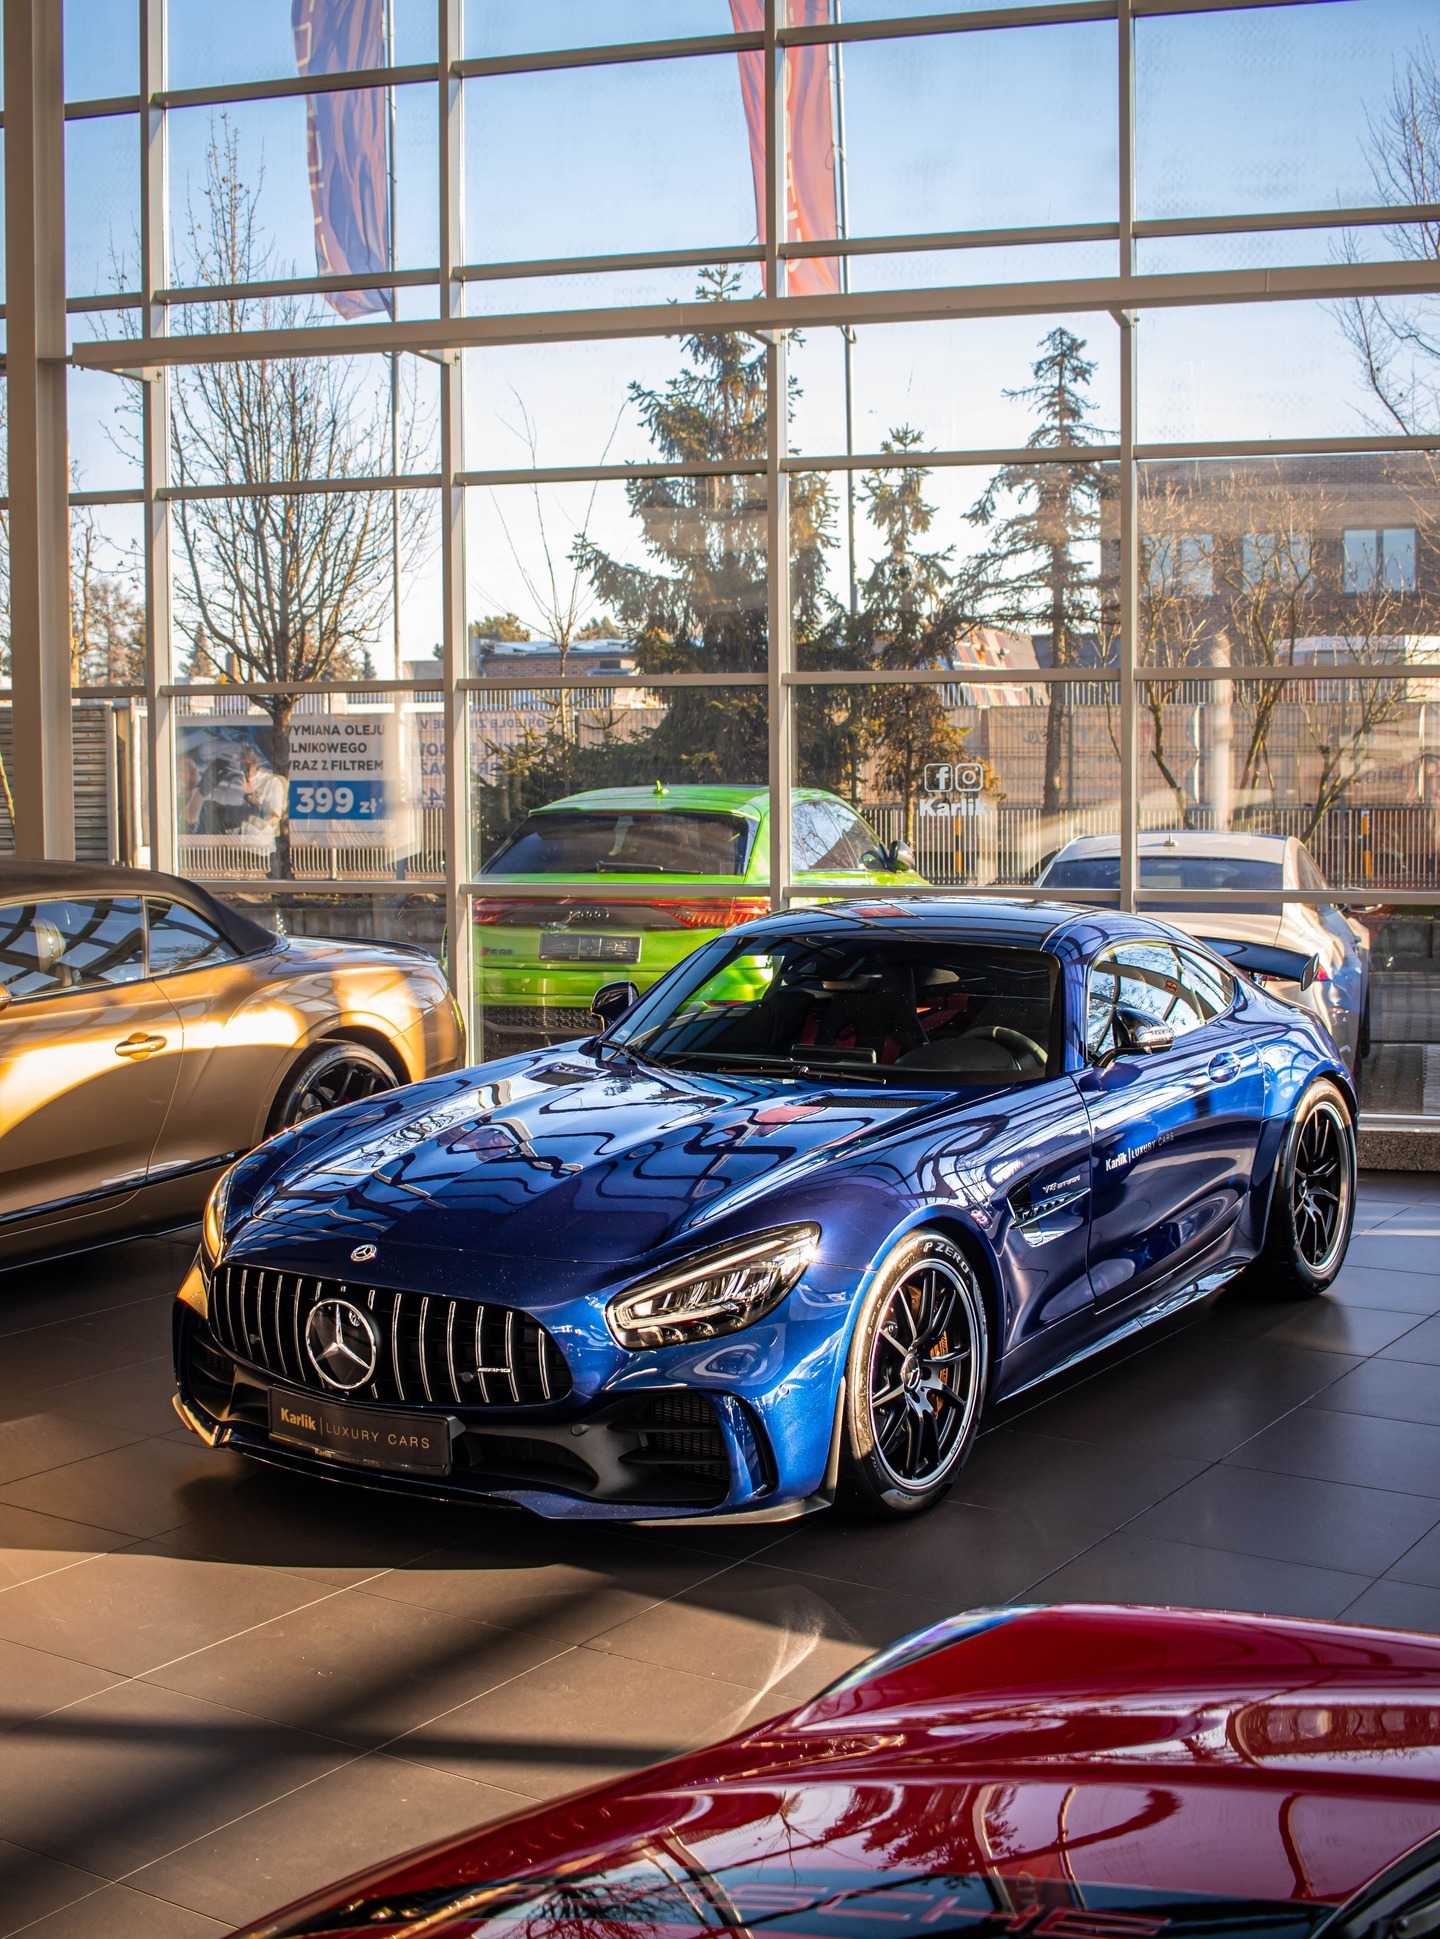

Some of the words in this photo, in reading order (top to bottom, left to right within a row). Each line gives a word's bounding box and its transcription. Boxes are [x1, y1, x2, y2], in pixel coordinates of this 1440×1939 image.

[344, 724, 385, 736] OLEJU
[289, 760, 318, 771] RAZ
[321, 760, 328, 771] Z
[331, 760, 384, 771] FILTREM
[295, 786, 355, 814] 399
[919, 798, 989, 817] Karlik
[1105, 1151, 1128, 1172] Karlik
[1131, 1140, 1156, 1159] LUXURY
[1157, 1131, 1175, 1147] CARS
[923, 1241, 933, 1253] P
[935, 1241, 970, 1274] ZERO
[280, 1407, 317, 1431] Karlik
[326, 1422, 380, 1442] LUXURY
[387, 1433, 431, 1449] CARS
